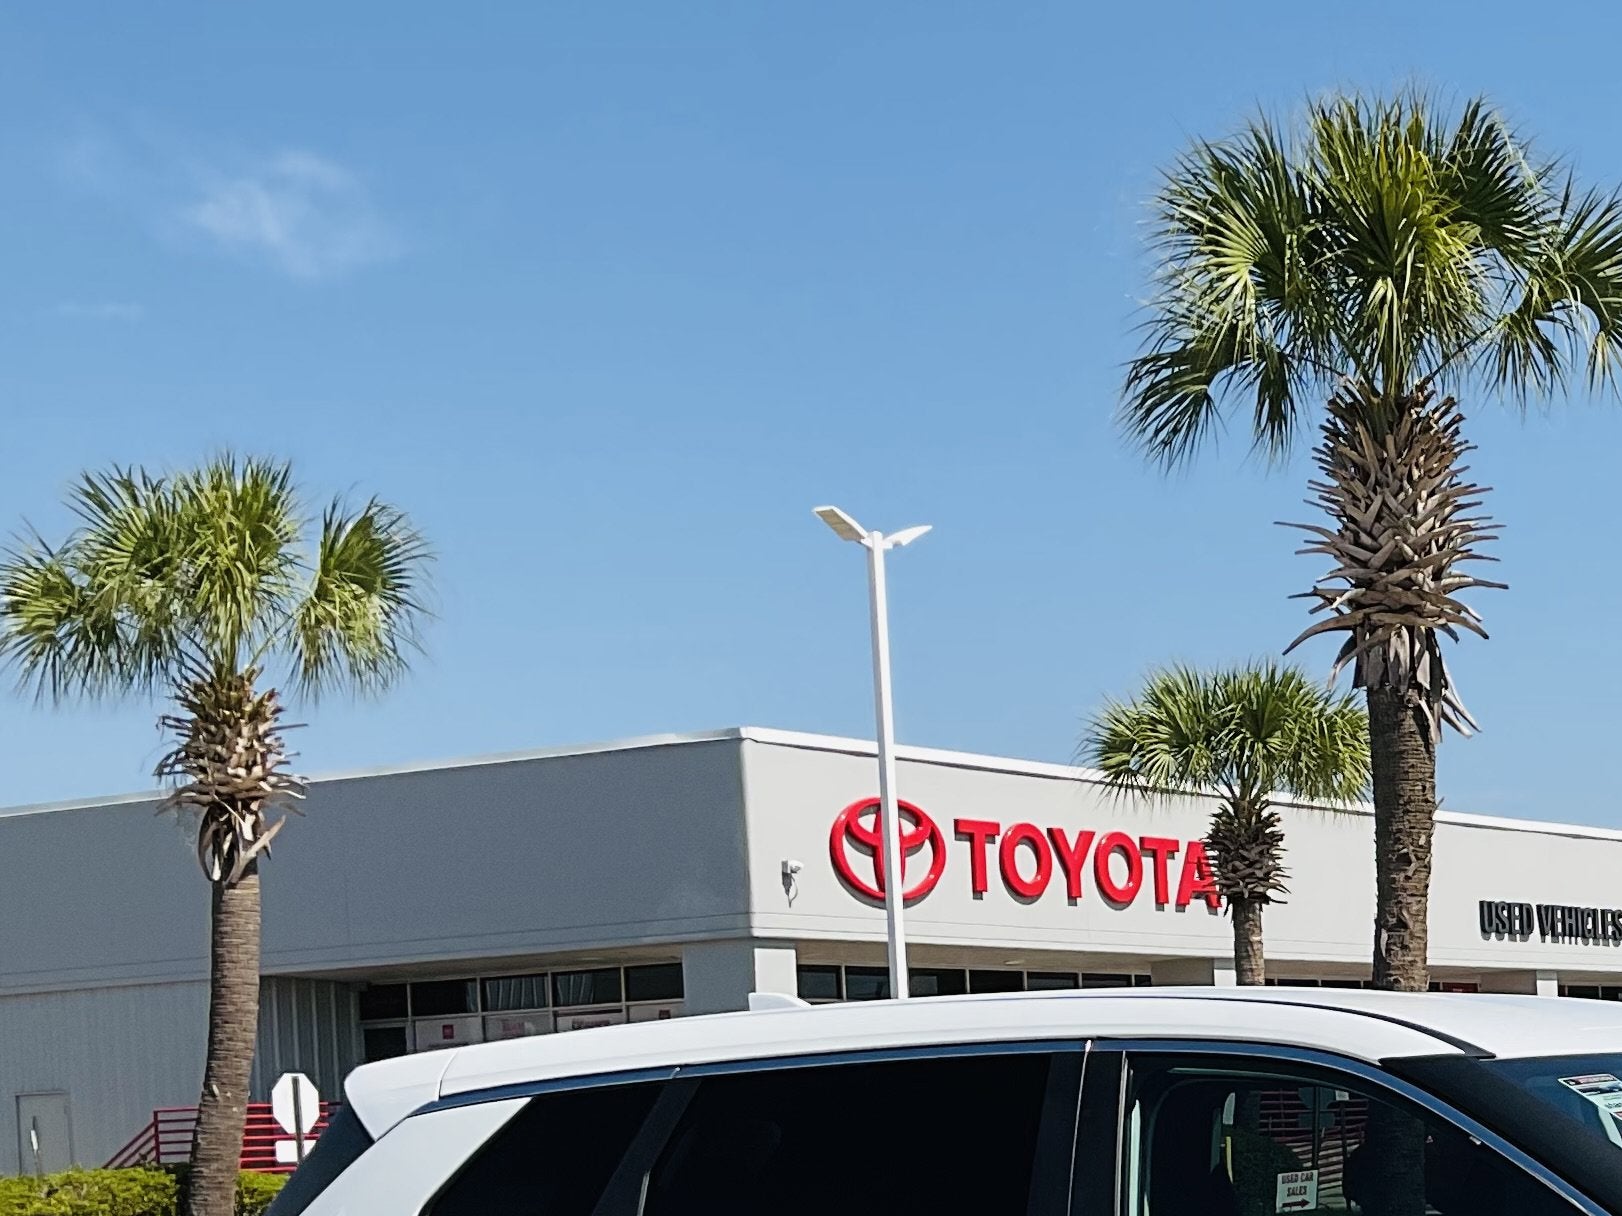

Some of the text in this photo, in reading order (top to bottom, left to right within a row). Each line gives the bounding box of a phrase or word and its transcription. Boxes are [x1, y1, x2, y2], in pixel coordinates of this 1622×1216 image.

[955, 818, 1223, 908] TOYOTA
[1479, 900, 1534, 937] USED
[1300, 1171, 1313, 1182] CAR
[1287, 1186, 1307, 1197] SALES
